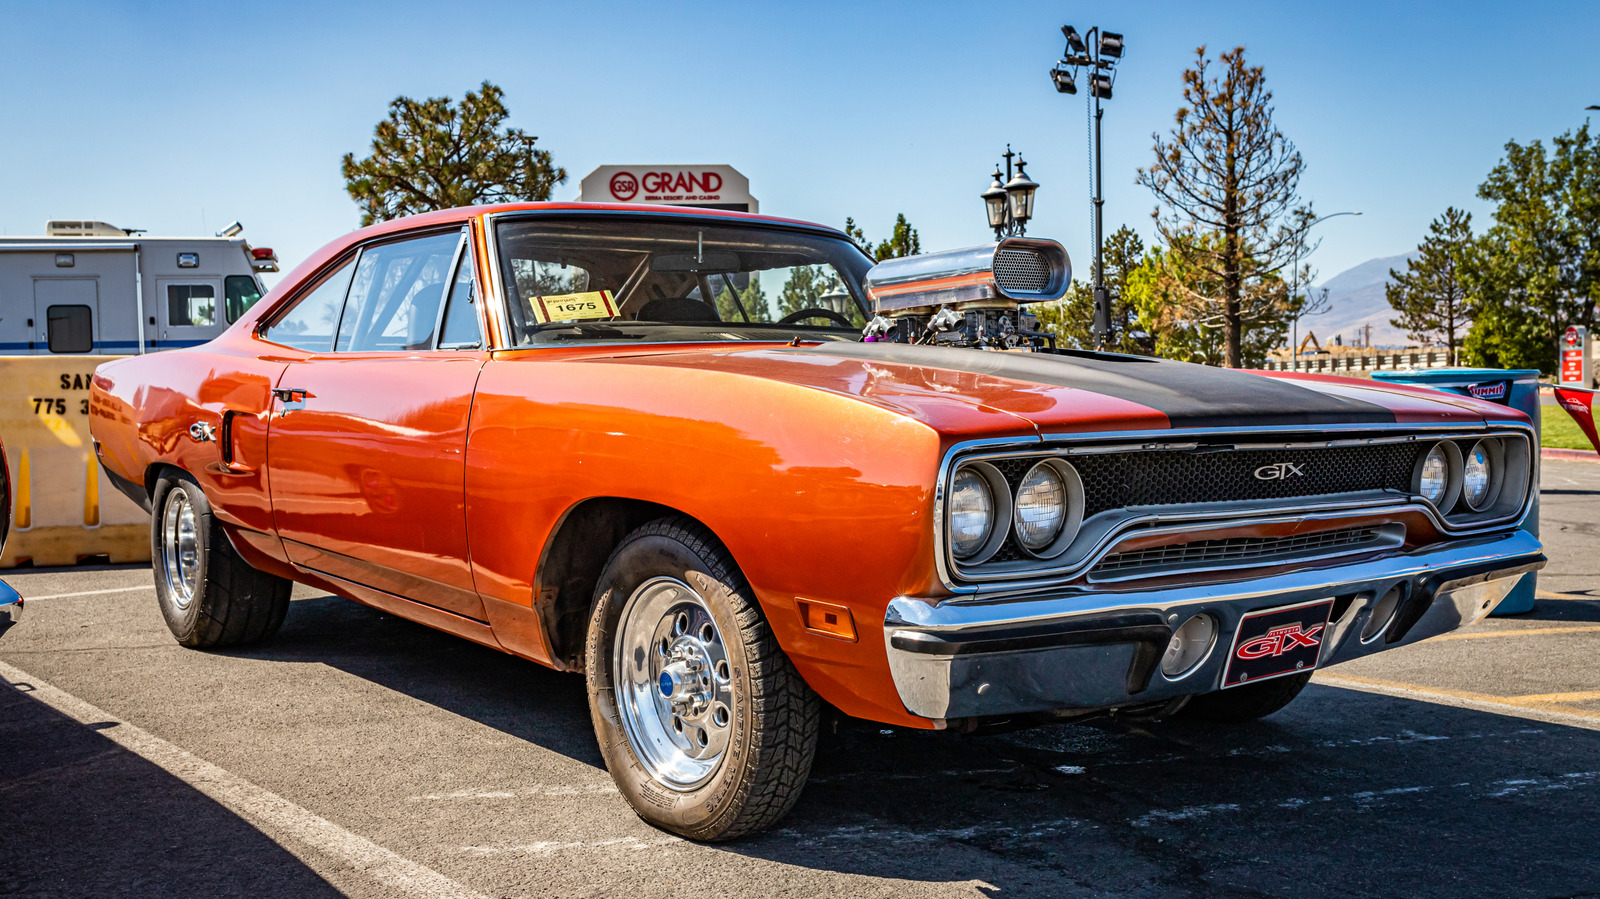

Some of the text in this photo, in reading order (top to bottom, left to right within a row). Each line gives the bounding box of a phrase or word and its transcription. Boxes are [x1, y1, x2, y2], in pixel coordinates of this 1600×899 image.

[613, 171, 723, 193] GSR GRAND
[556, 302, 597, 312] 1675
[1469, 384, 1504, 396] SUMMIT
[33, 398, 66, 415] 775
[190, 421, 217, 441] GTX
[1254, 462, 1306, 480] GTX
[1269, 627, 1300, 637] PLYMOUTH
[1236, 624, 1324, 660] GTX
[733, 666, 745, 761] STARFIRE
